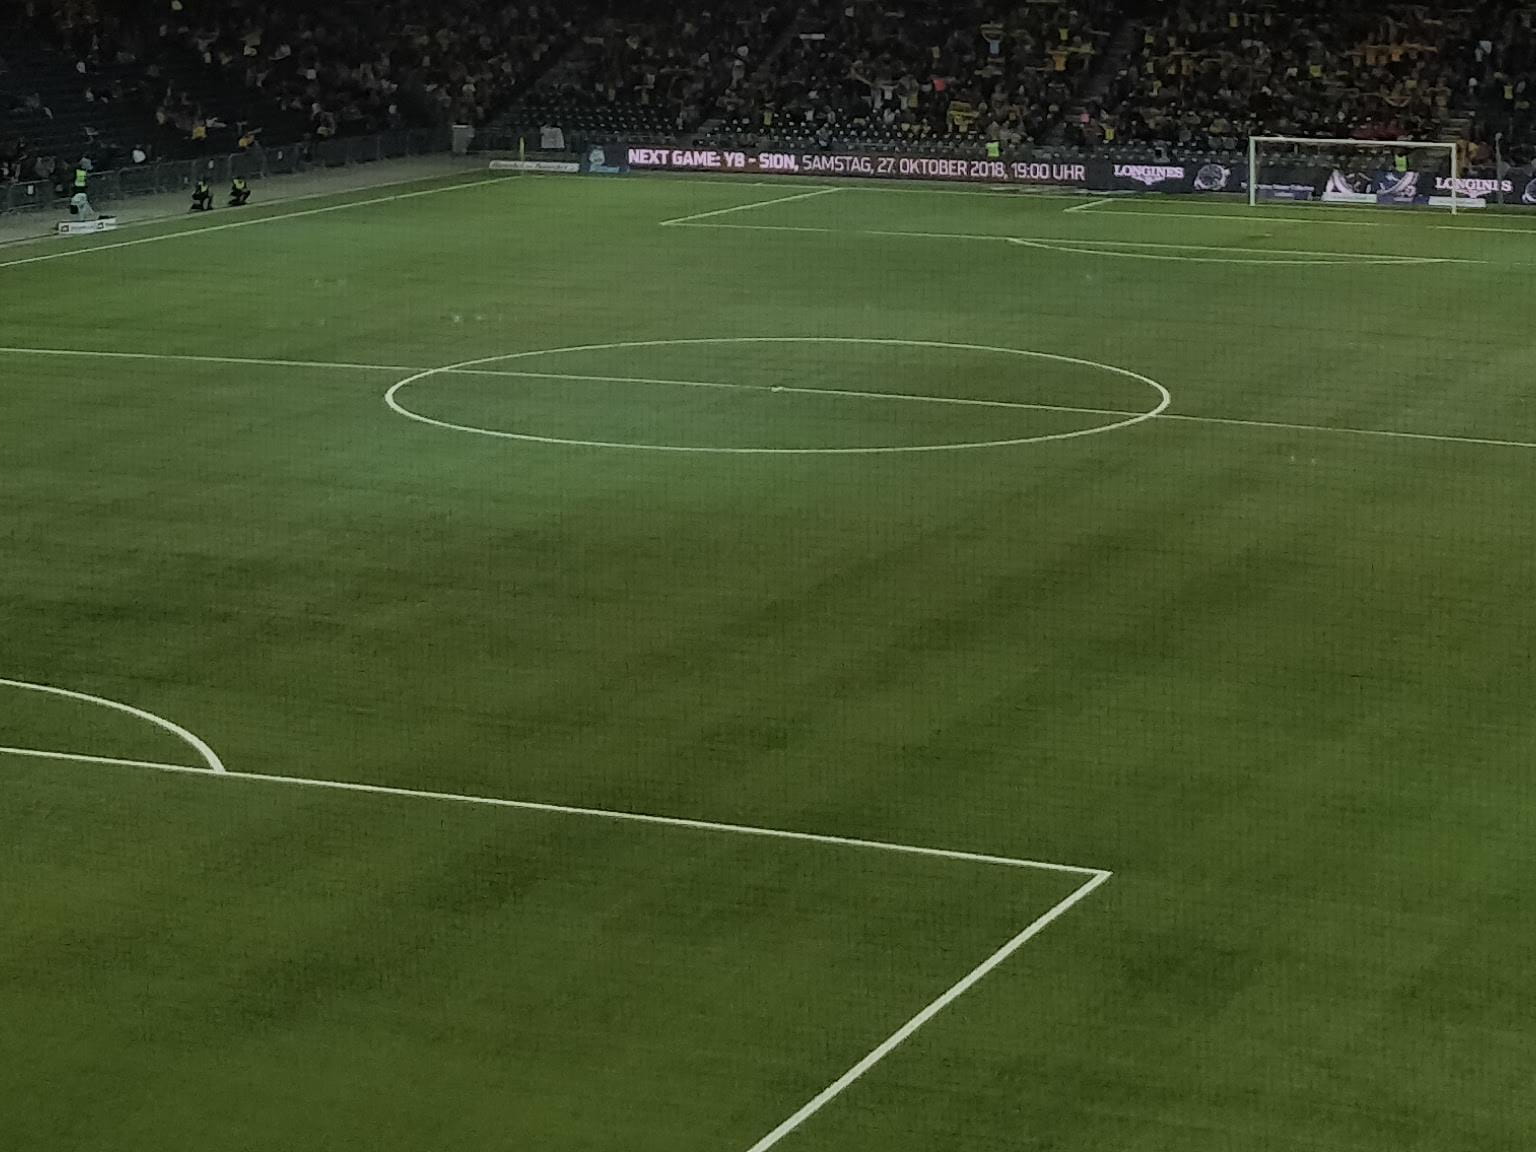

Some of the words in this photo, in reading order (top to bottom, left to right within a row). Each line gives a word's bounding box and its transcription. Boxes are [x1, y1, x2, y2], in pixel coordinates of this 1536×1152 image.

[628, 147, 670, 164] NEXT
[671, 149, 722, 167] GAME:
[723, 151, 745, 168] YB
[759, 152, 799, 172] SION,
[802, 157, 875, 175] SAMSTAG,
[877, 158, 895, 174] 27.
[899, 158, 968, 176] OKTOBER
[970, 161, 1008, 179] 2018,
[1012, 162, 1049, 180] 19:00
[1053, 164, 1085, 181] UHR
[1112, 163, 1185, 179] LONGINES
